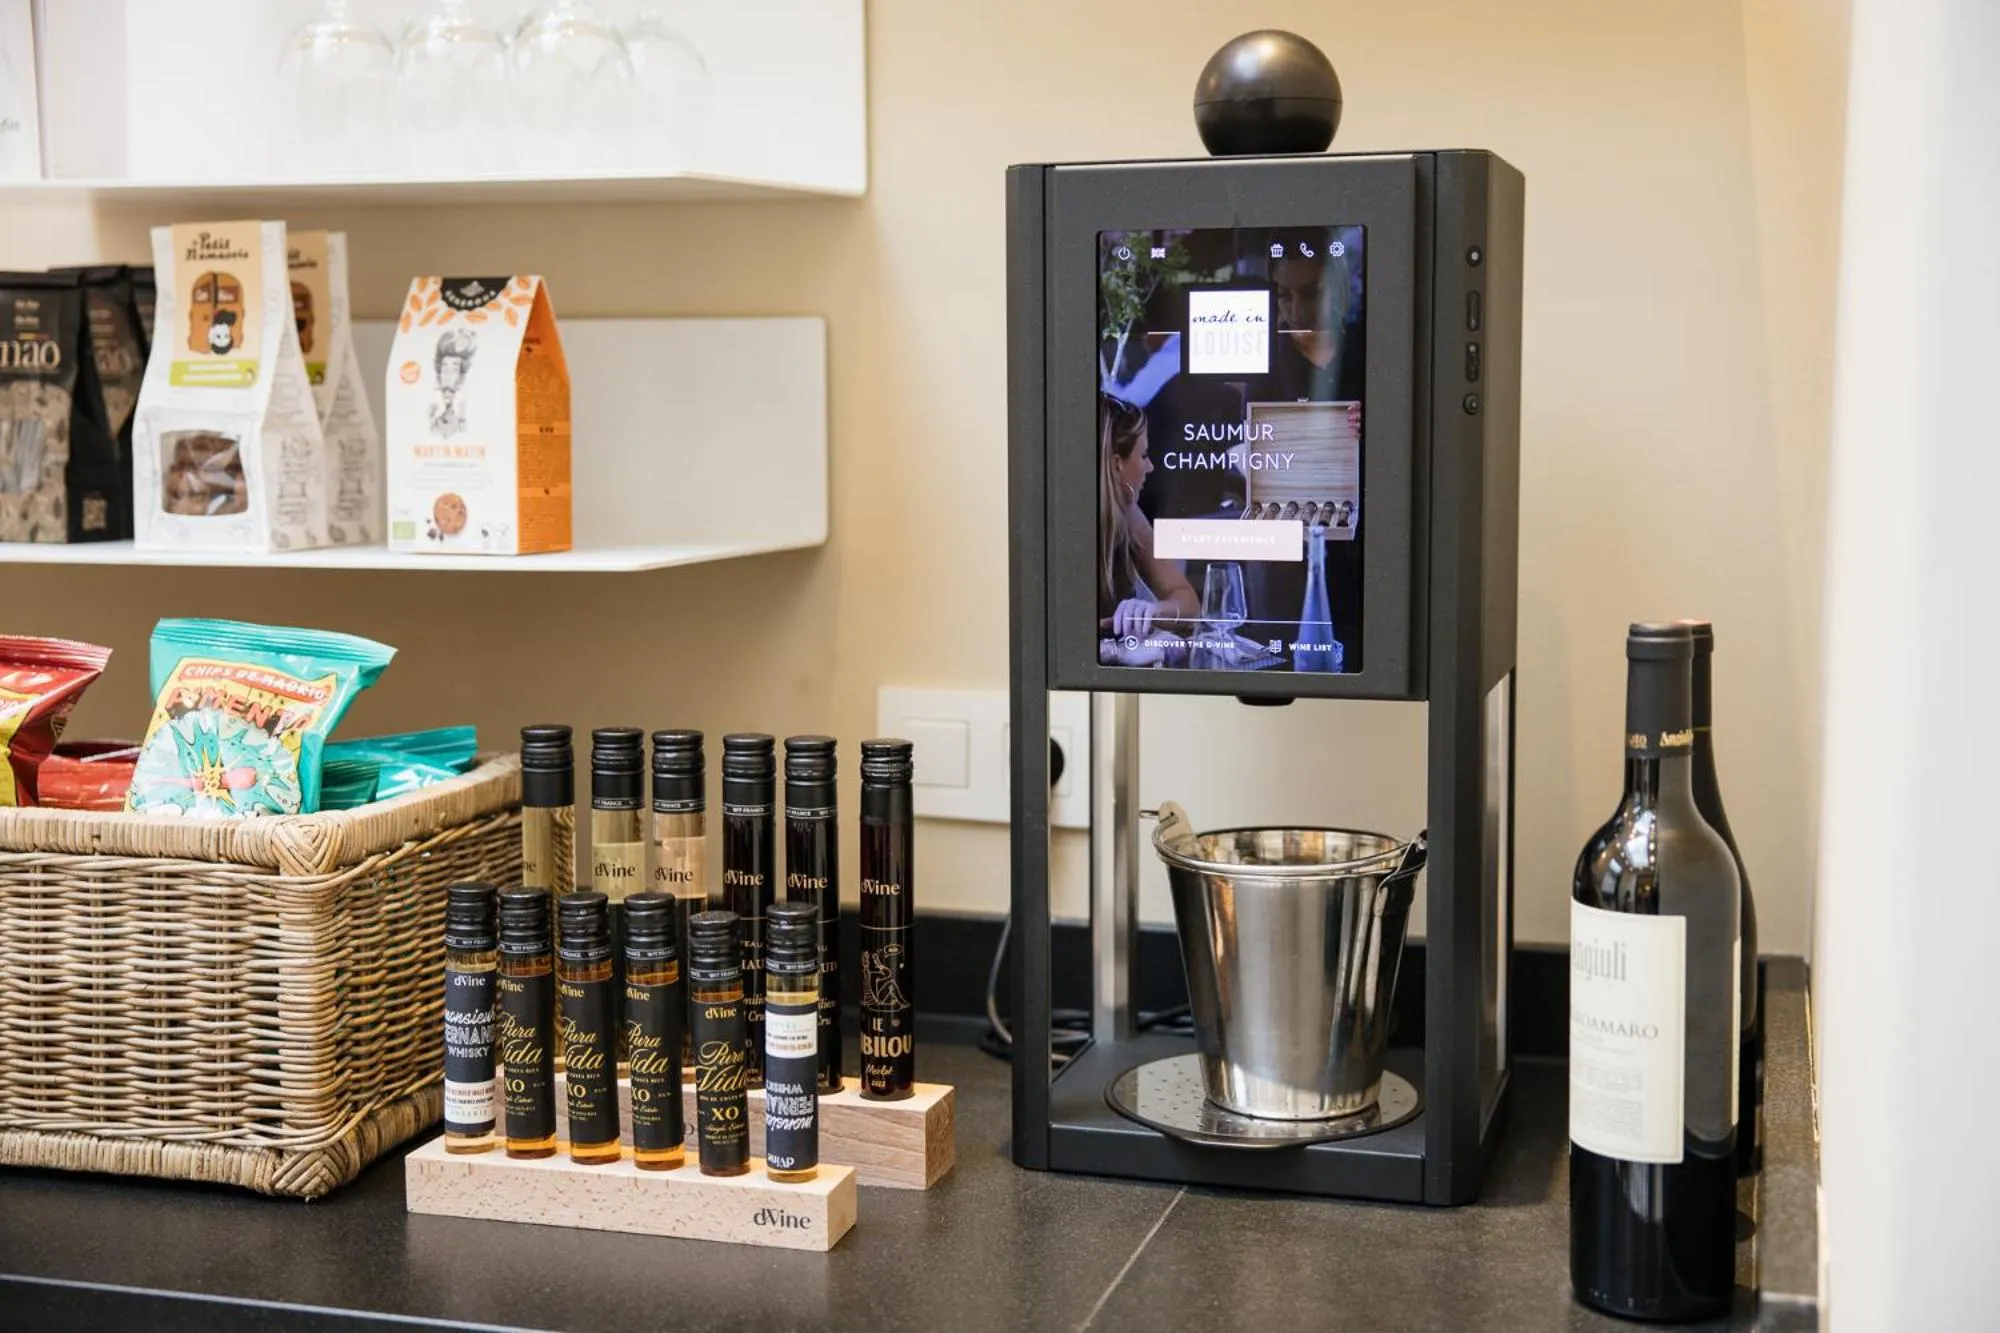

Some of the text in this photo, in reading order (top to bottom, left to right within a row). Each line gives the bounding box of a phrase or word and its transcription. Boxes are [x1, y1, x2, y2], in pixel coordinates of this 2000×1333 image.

[1192, 308, 1266, 324] made in
[1183, 423, 1274, 441] SAUMUR
[1163, 452, 1296, 471] CHAMPIGNY
[1181, 534, 1277, 545] START EXPERIENCE
[1144, 639, 1185, 648] DISCOVER
[1187, 640, 1204, 649] THE
[1288, 643, 1333, 652] WINE LIST
[184, 664, 234, 678] CHIPS
[594, 863, 636, 878] dVine
[654, 865, 694, 883] dVine
[723, 868, 765, 886] dVine
[787, 872, 829, 889] dVine
[861, 878, 901, 896] dVine
[453, 974, 487, 987] dVine
[704, 1006, 737, 1020] dVine
[872, 1016, 885, 1032] LE
[447, 1045, 490, 1058] WHISKY
[711, 1105, 740, 1121] XO
[753, 1207, 812, 1230] dVine
